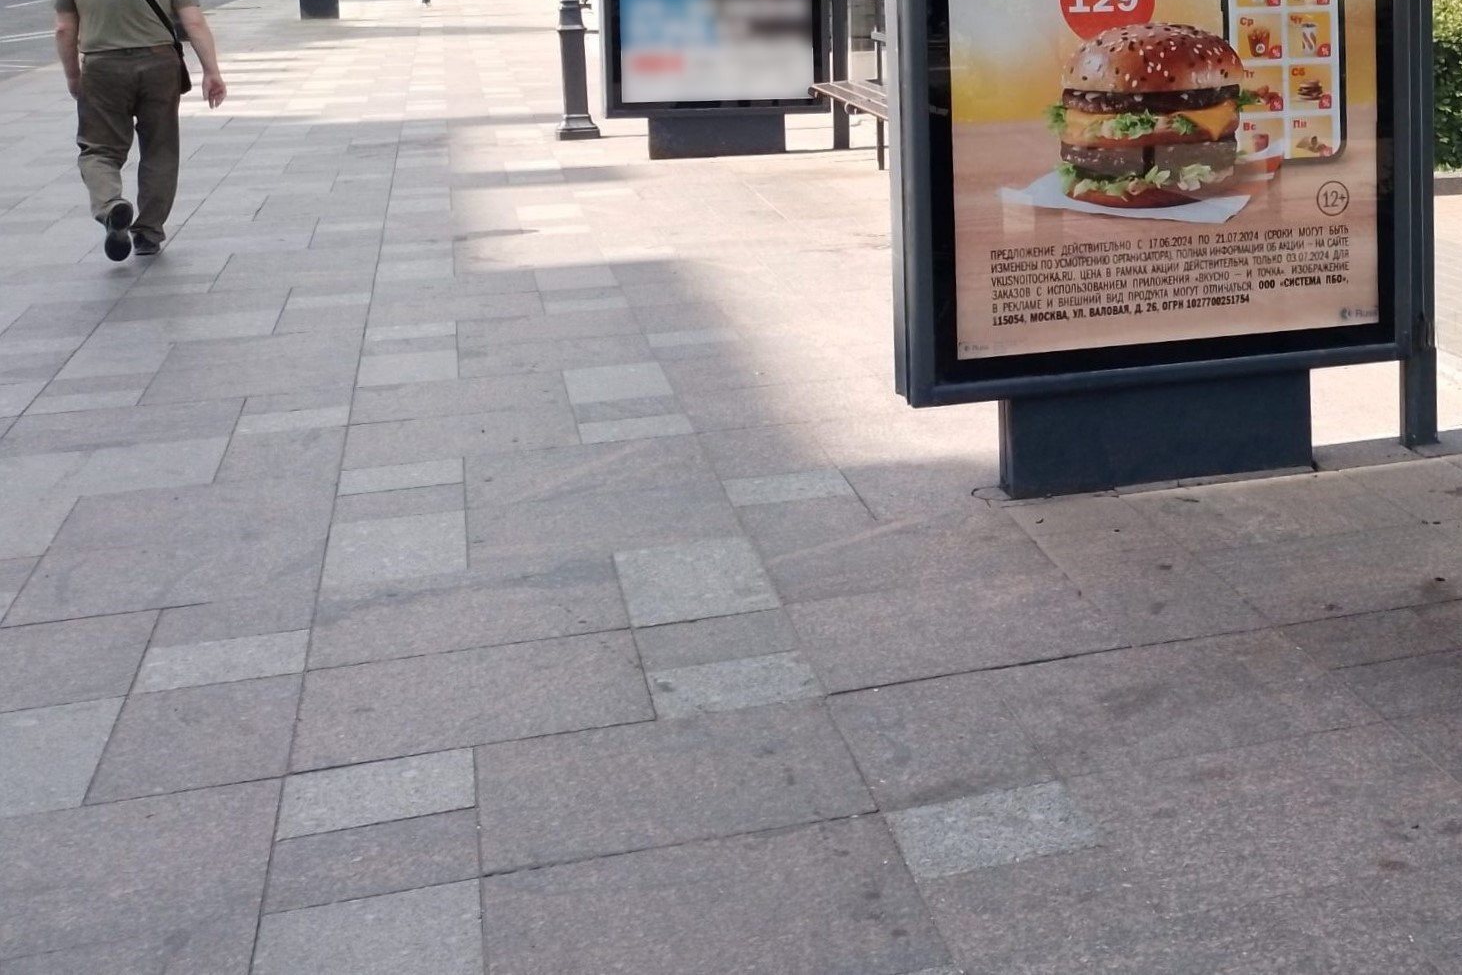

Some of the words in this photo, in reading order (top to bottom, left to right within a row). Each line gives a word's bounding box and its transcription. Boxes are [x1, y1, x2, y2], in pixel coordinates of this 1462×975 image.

[1240, 17, 1254, 27] Ср
[1291, 67, 1306, 77] Сб
[1243, 123, 1256, 131] Вс
[1323, 190, 1347, 208] 12+
[990, 247, 1054, 261] ПРЕДЛОЖЕНИЕ
[1061, 241, 1130, 256] ДЕЙСТВИТЕЛЬНО
[1137, 240, 1141, 249] С
[1198, 235, 1209, 244] ПО
[1215, 232, 1258, 243] 21.07.2024
[1264, 229, 1292, 239] (СРОКИ
[1298, 227, 1322, 237] МОГУТ
[1329, 225, 1348, 234] БЫТЬ
[990, 261, 1037, 273] ИЗМЕНЕНЫ
[1041, 260, 1052, 269] ПО
[1055, 255, 1109, 268] УСМОТРЕНИЮ
[1176, 248, 1206, 258] ПОЛНАЯ
[1209, 244, 1263, 256] ИНФОРМАЦИЯ
[1266, 243, 1276, 251] ОБ
[1279, 241, 1303, 251] АКЦИИ
[1315, 239, 1324, 247] НА
[1327, 237, 1348, 246] САЙТЕ
[1080, 269, 1101, 280] ЦЕНА
[1106, 268, 1111, 276] В
[1115, 265, 1147, 276] РАМКАХ
[1151, 263, 1178, 274] АКЦИИ
[1183, 257, 1248, 272] ДЕЙСТВИТЕЛЬНА
[1252, 255, 1282, 265] ТОЛЬКО
[1333, 249, 1348, 259] ДЛЯ
[992, 288, 1030, 300] ЗАКАЗОВ
[1036, 287, 1041, 296] С
[1047, 279, 1126, 295] ИСПОЛЬЗОВАНИЕМ
[1132, 274, 1189, 288] ПРИЛОЖЕНИЯ
[1246, 269, 1251, 279] И
[1291, 261, 1349, 275] ИЗОБРАЖЕНИЕ
[992, 304, 997, 313] В
[1003, 300, 1041, 312] РЕКЛАМЕ
[1046, 299, 1052, 308] И
[1058, 293, 1100, 307] ВНЕШНИЙ
[1106, 292, 1123, 303] ВИД
[1128, 288, 1167, 303] ПРОДУКТА
[1173, 285, 1197, 297] МОГУТ
[1258, 280, 1274, 290] ООО
[1073, 308, 1086, 317] УЛ.
[1162, 299, 1183, 311] ОГРН
